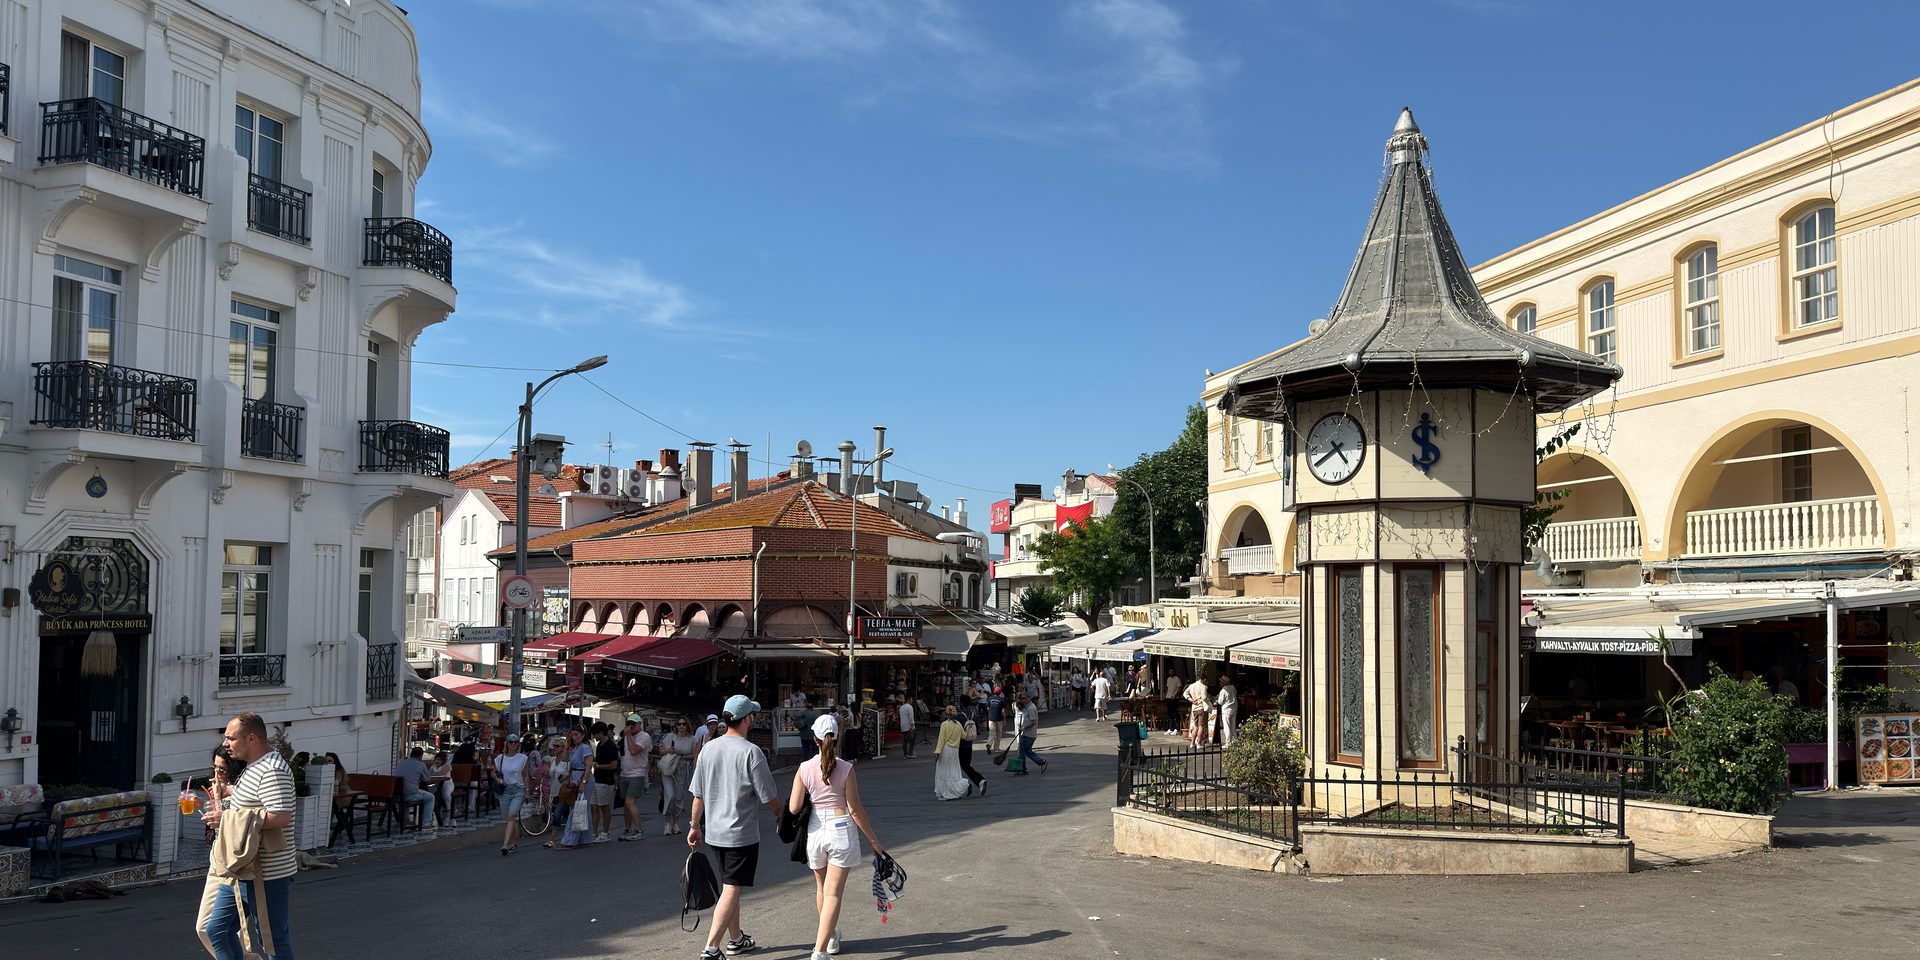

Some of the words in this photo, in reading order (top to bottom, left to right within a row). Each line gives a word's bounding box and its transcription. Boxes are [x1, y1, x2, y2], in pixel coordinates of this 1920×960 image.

[1332, 472, 1342, 480] VI
[866, 619, 917, 628] TERRA-MARE
[1171, 609, 1189, 628] dolci
[46, 618, 73, 630] BÜYÜK
[74, 620, 88, 629] ADA
[89, 619, 124, 629] PRINCESS
[125, 619, 148, 628] HOTEL
[1540, 640, 1600, 652] KAHVALTI-AYVALIK
[1600, 640, 1659, 652] TOST-PİZZA-PİDE
[525, 672, 543, 681] kenstein
